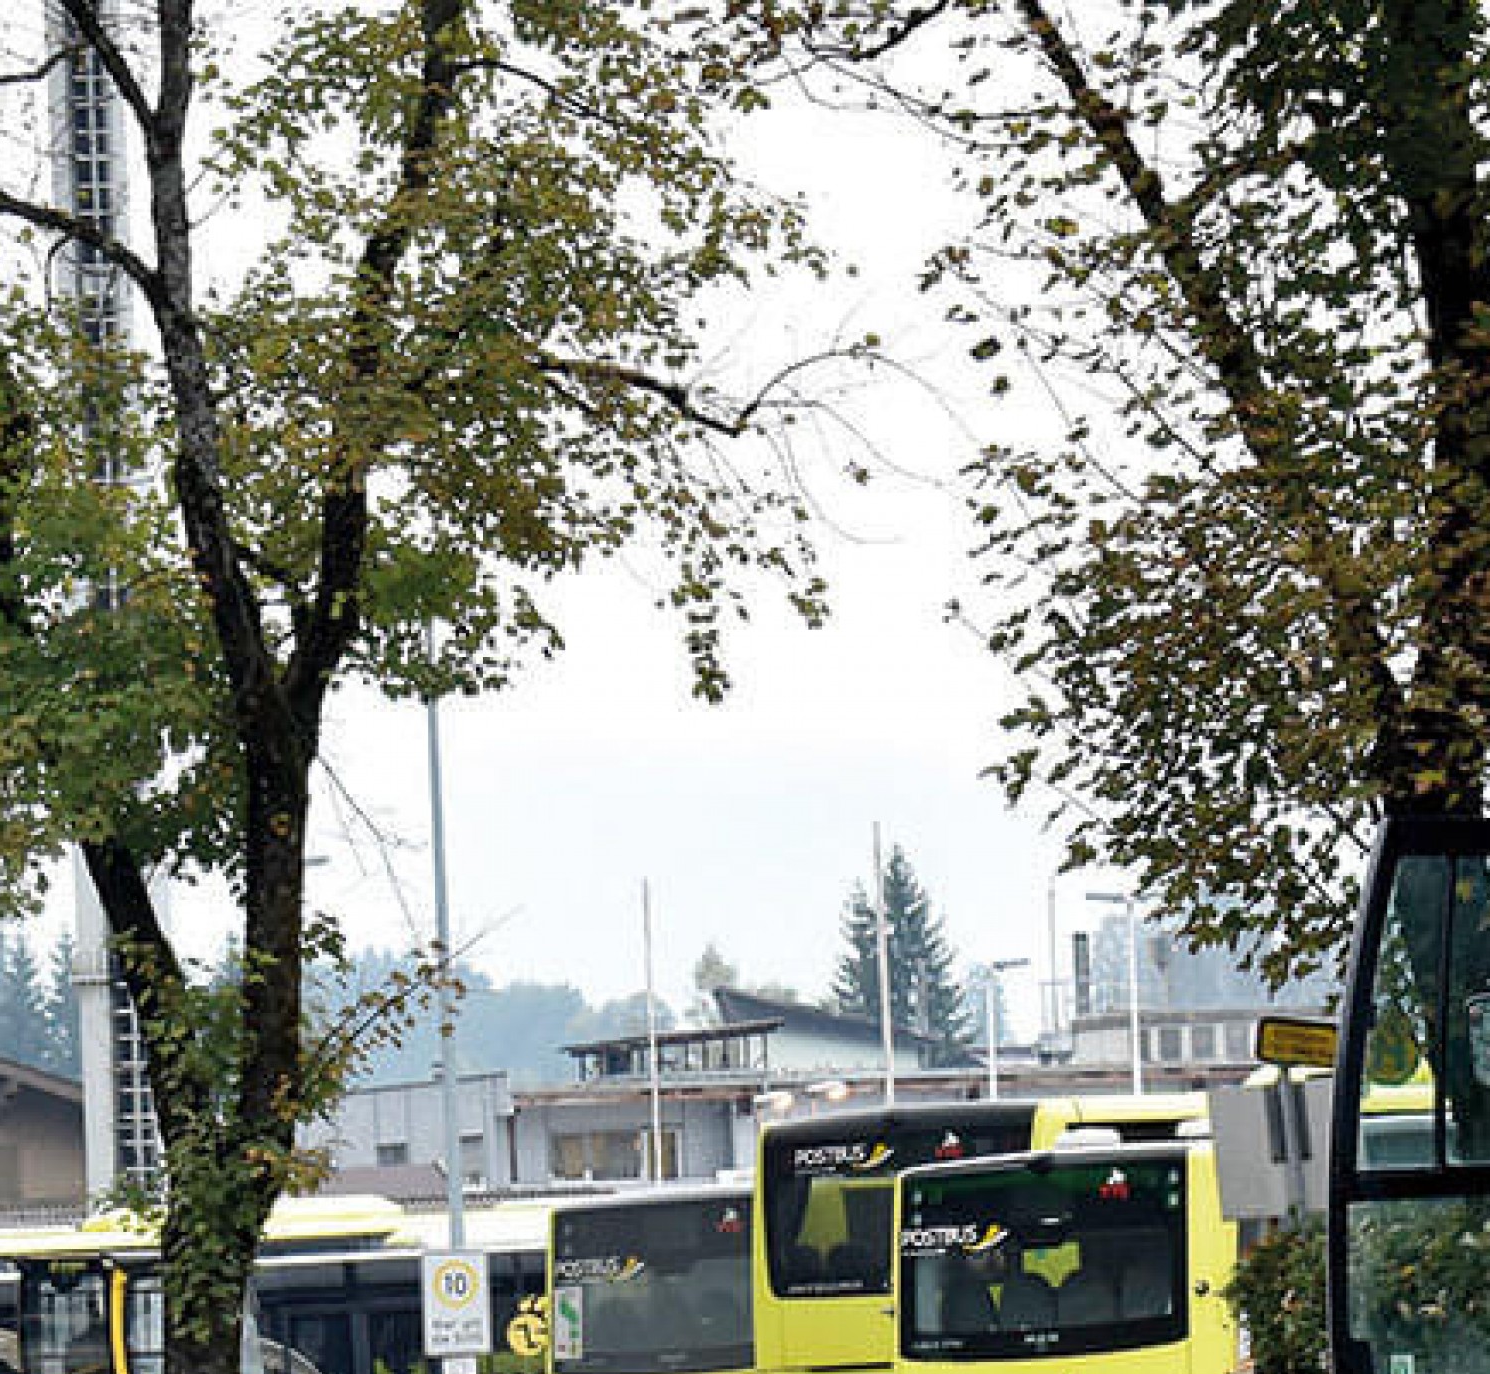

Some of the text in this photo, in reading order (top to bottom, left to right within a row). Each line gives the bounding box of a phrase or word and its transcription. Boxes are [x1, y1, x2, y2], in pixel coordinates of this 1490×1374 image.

[794, 1143, 866, 1168] POSTBUS
[900, 1223, 976, 1247] POSTBUS
[554, 1255, 621, 1278] POSTBUS
[444, 1272, 467, 1296] 10
